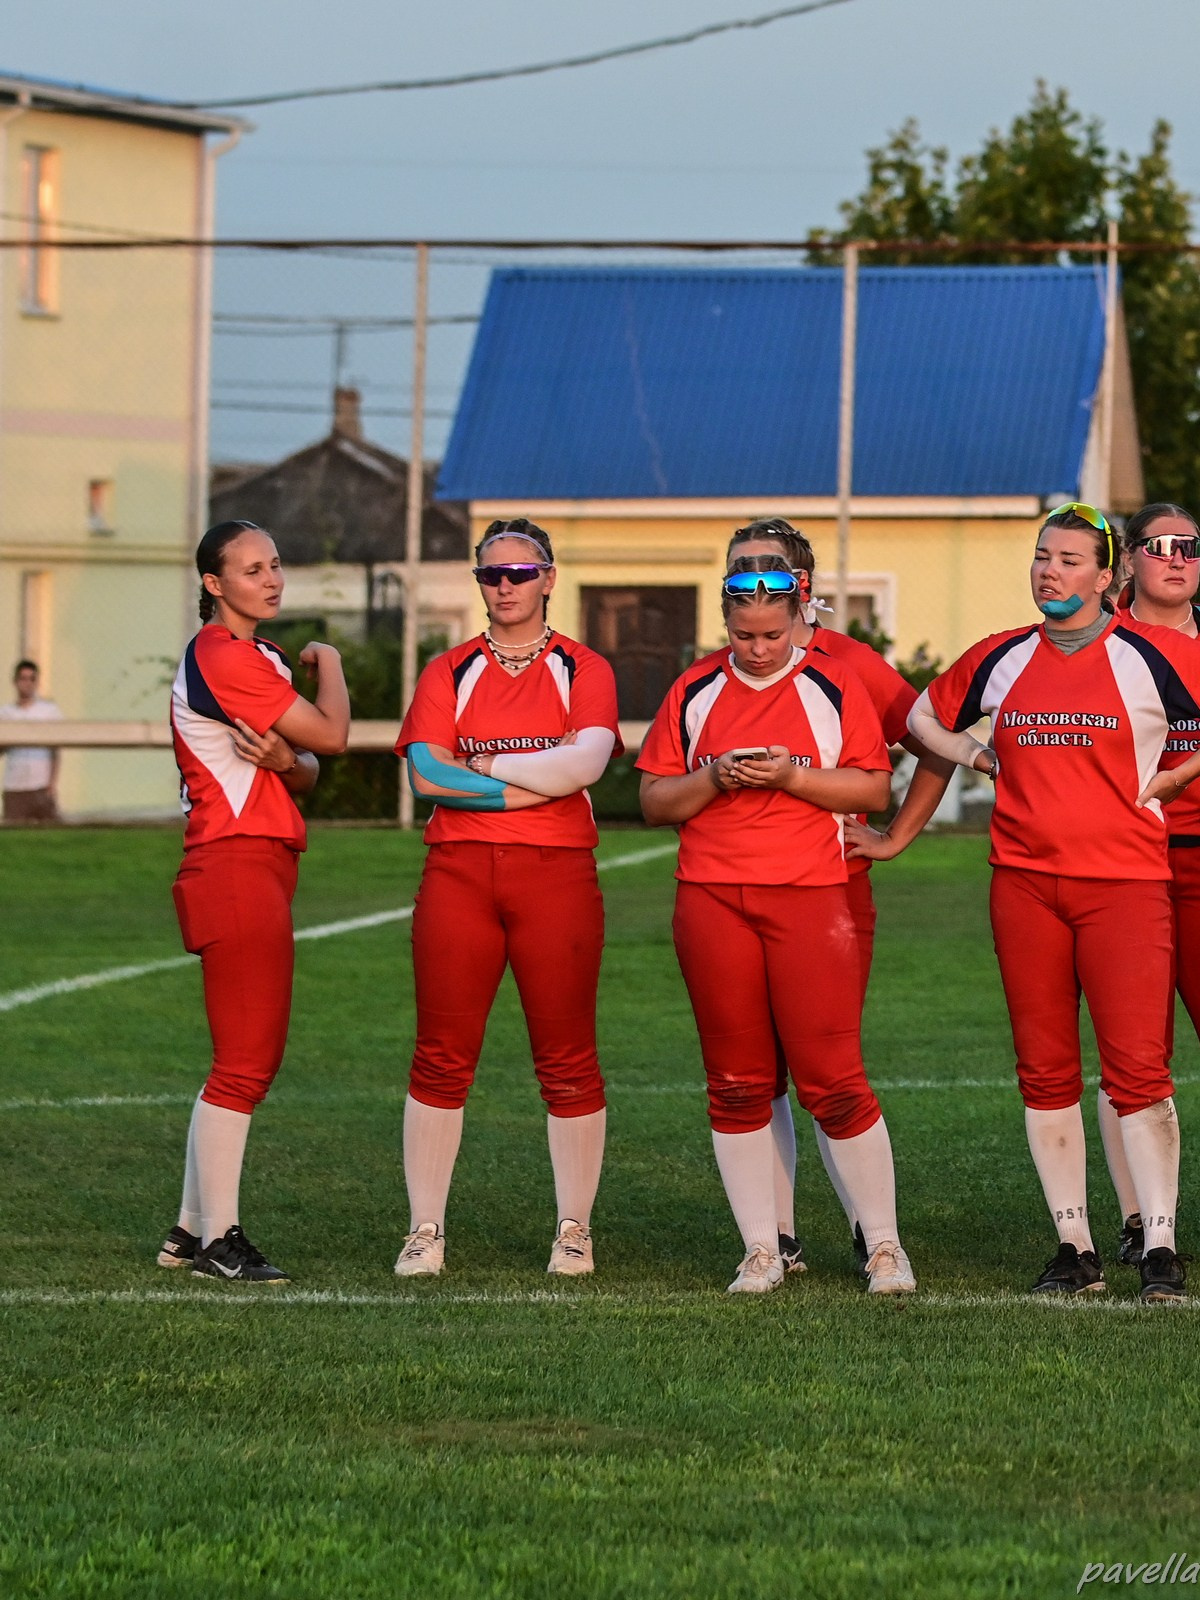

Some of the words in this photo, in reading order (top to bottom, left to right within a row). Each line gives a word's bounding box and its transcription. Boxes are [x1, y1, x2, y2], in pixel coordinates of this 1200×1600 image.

[1001, 710, 1120, 730] Московская
[458, 736, 564, 753] Московск
[1016, 729, 1093, 747] область
[1056, 1206, 1087, 1223] PST
[1142, 1215, 1174, 1229] IPS
